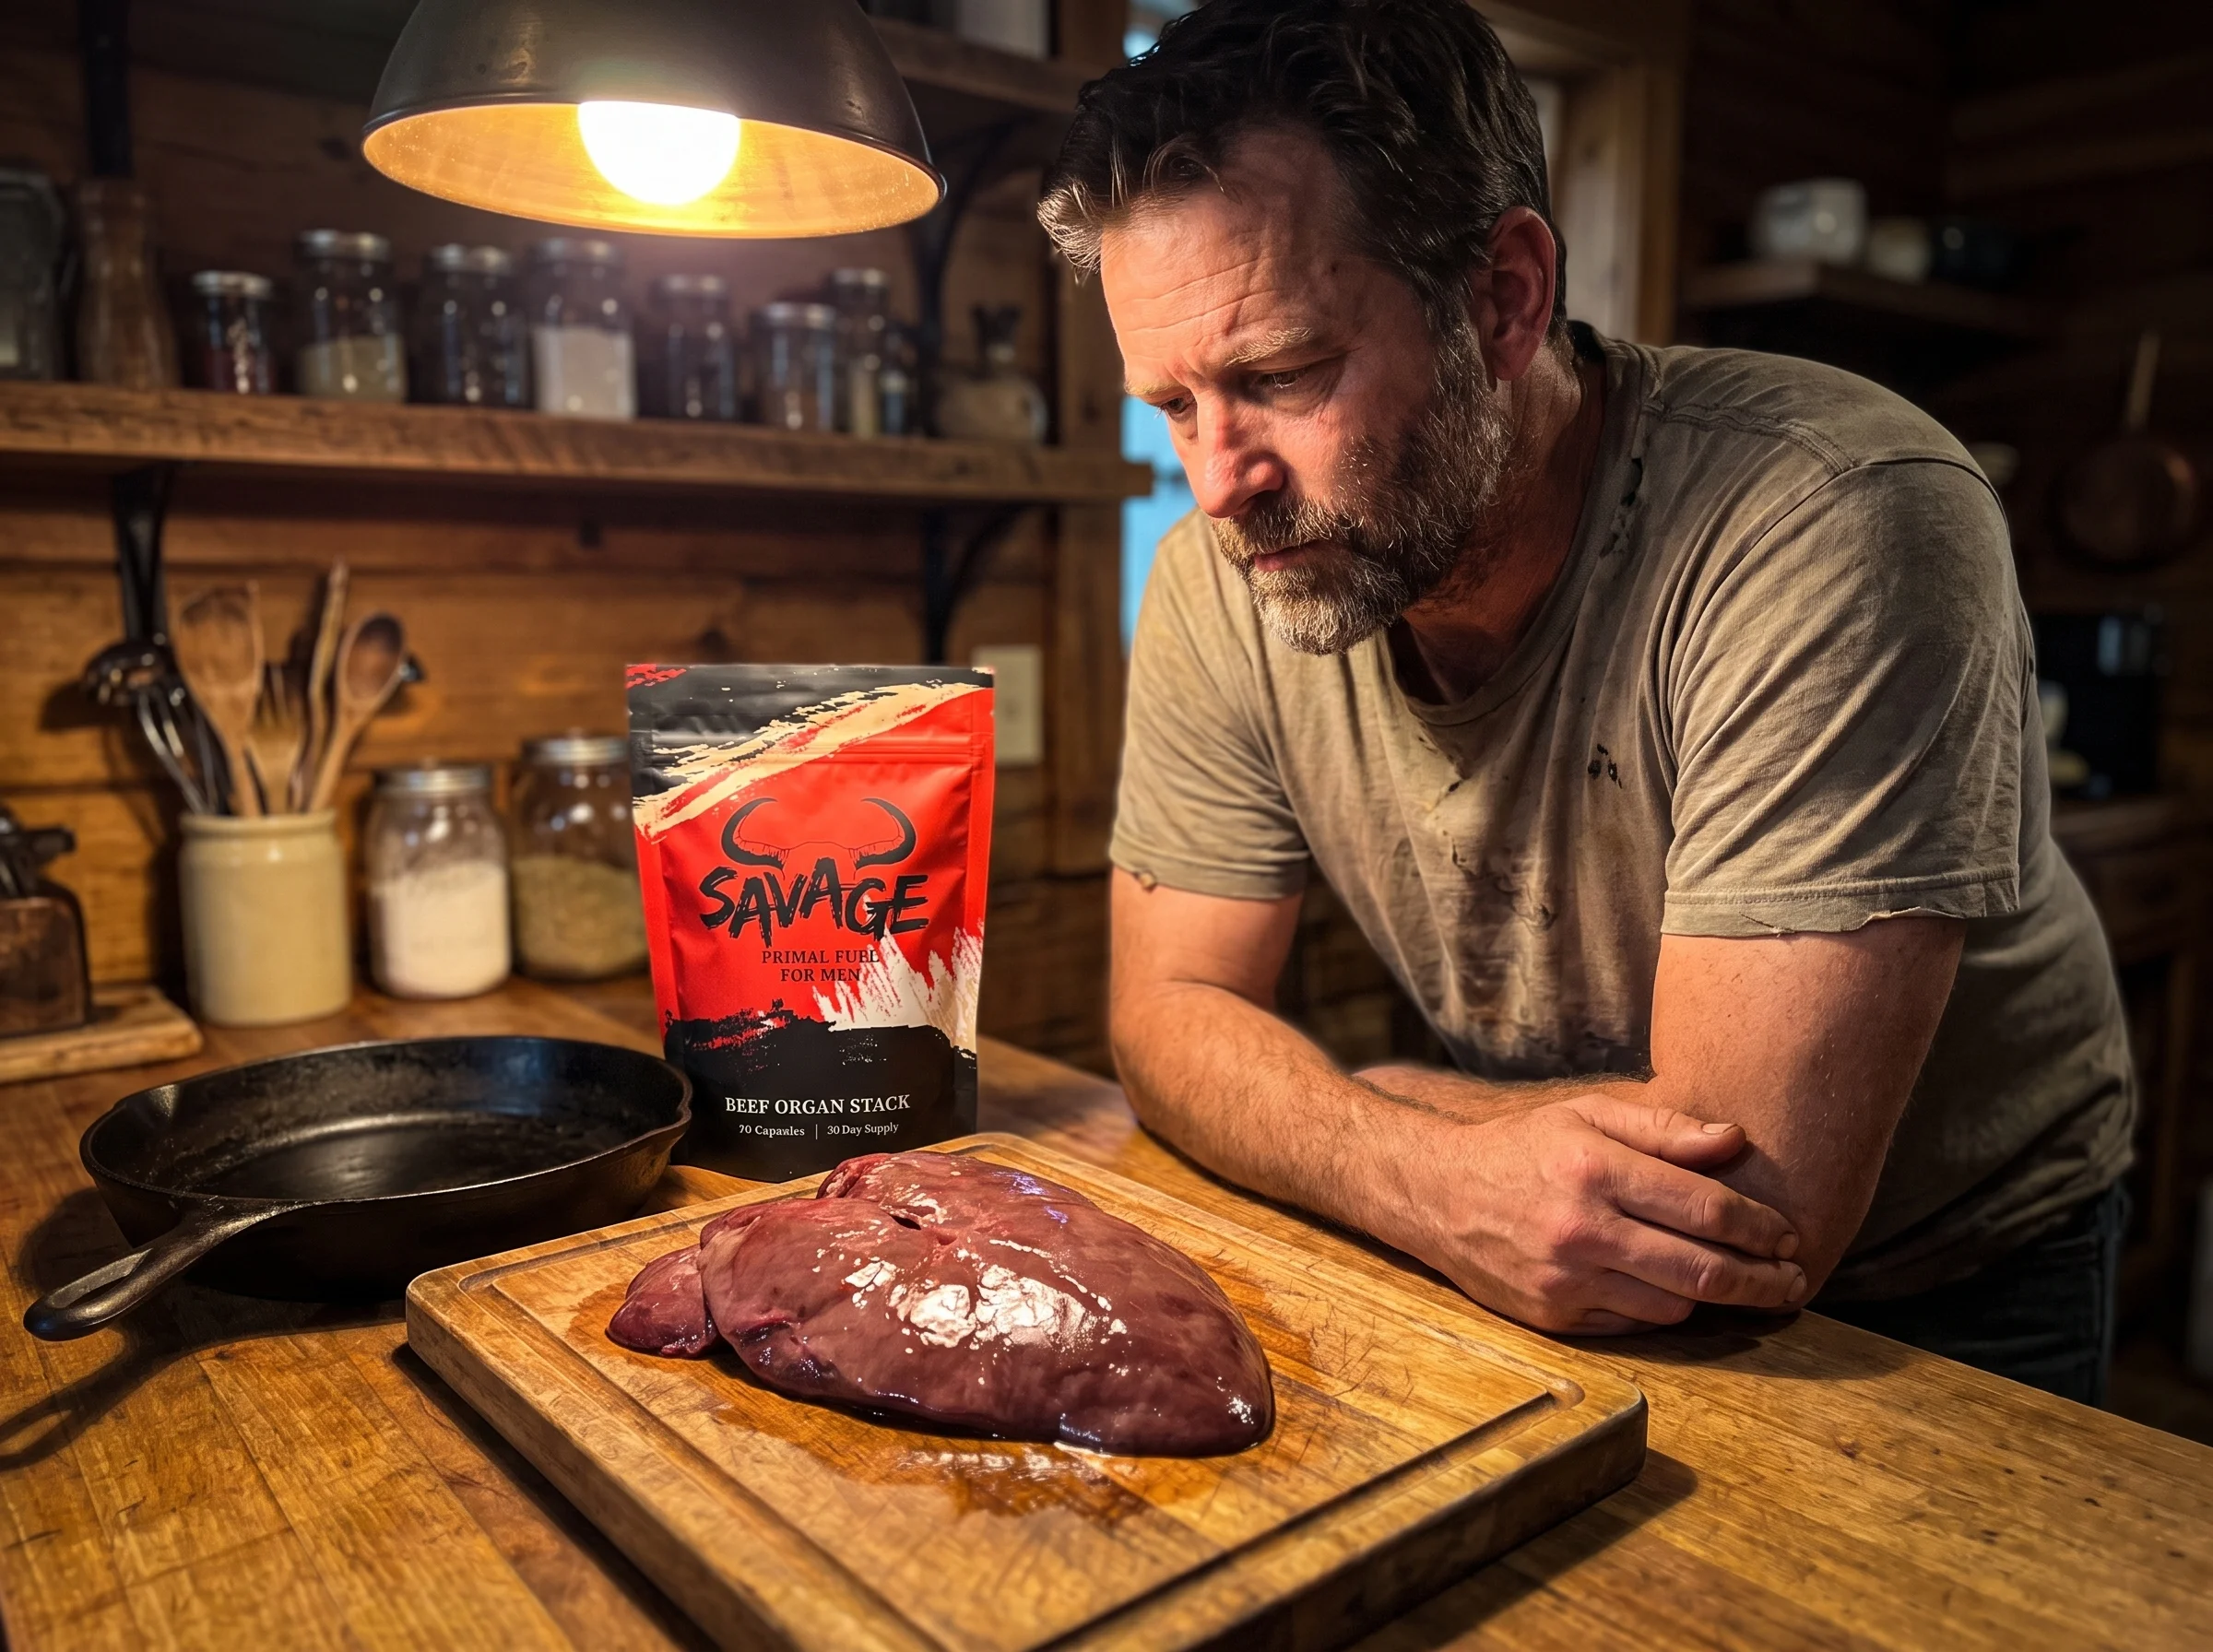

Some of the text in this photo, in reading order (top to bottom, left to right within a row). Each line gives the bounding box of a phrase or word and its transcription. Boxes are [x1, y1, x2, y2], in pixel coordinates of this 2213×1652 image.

[699, 856, 929, 948] SAVAGE
[762, 950, 830, 963] PRIMAL
[780, 968, 860, 982] FOR MEN
[725, 1094, 911, 1115] BEEF ORGAN STACK
[826, 1125, 840, 1135] 30
[842, 1125, 862, 1137] Day
[864, 1121, 899, 1136] Supply
